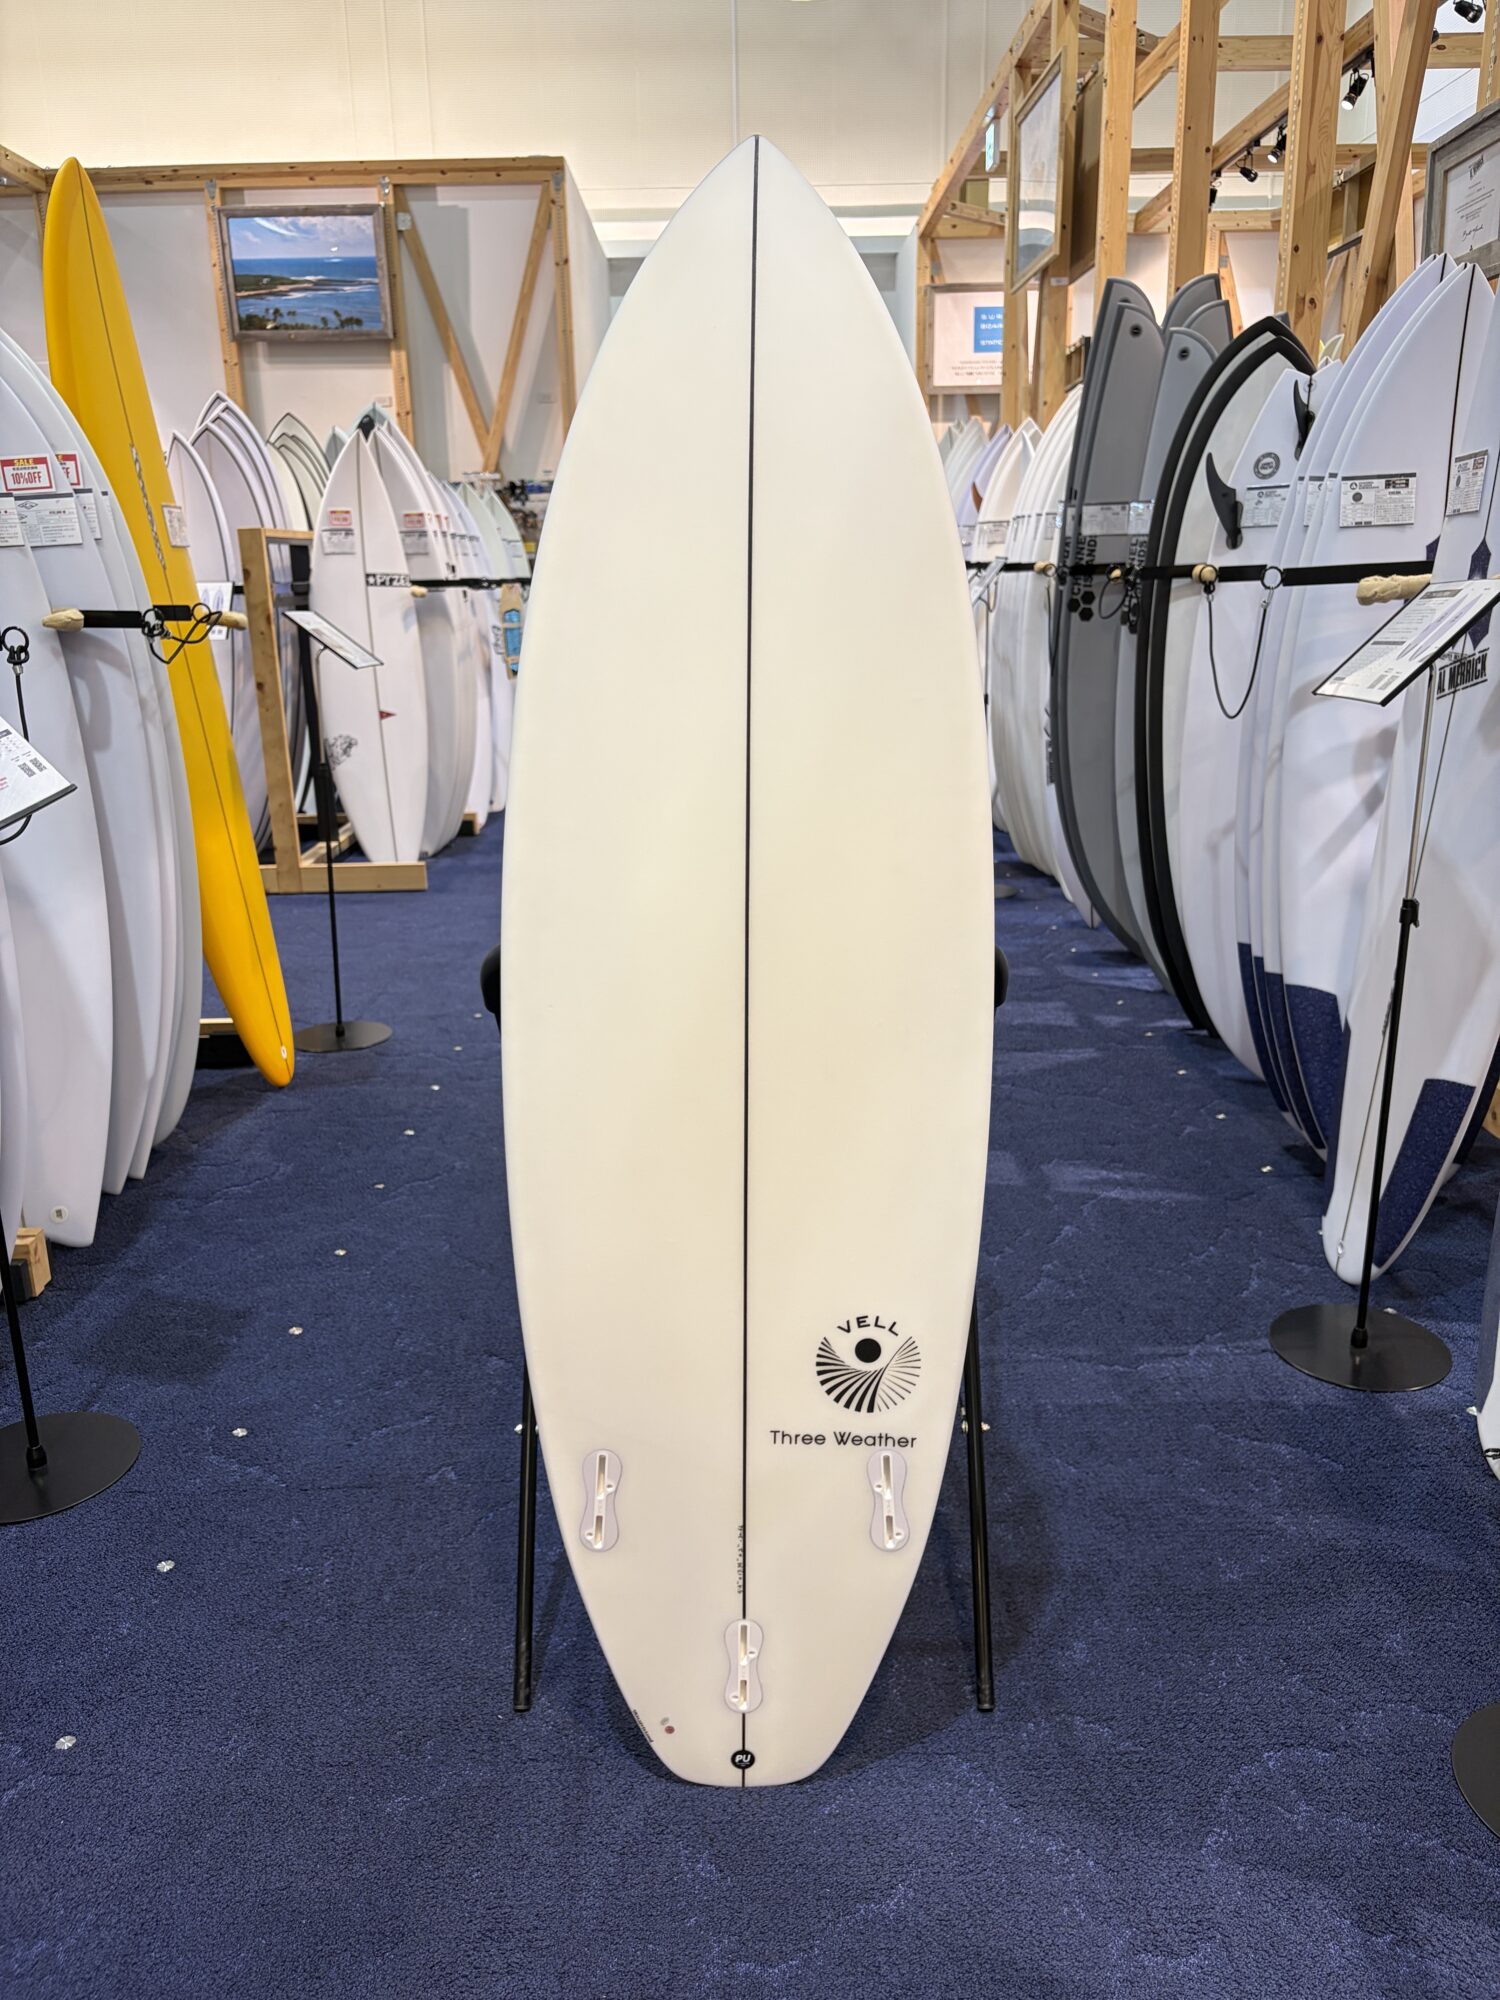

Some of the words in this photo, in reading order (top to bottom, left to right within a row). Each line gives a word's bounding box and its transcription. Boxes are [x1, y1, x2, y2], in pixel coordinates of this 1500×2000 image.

[11, 471, 42, 485] 10%OFF
[1437, 670, 1446, 695] AL
[1448, 652, 1488, 691] MERRICK
[837, 1315, 899, 1337] VELL
[770, 1430, 826, 1445] Three
[833, 1431, 917, 1448] Weather
[735, 1755, 751, 1763] PU
